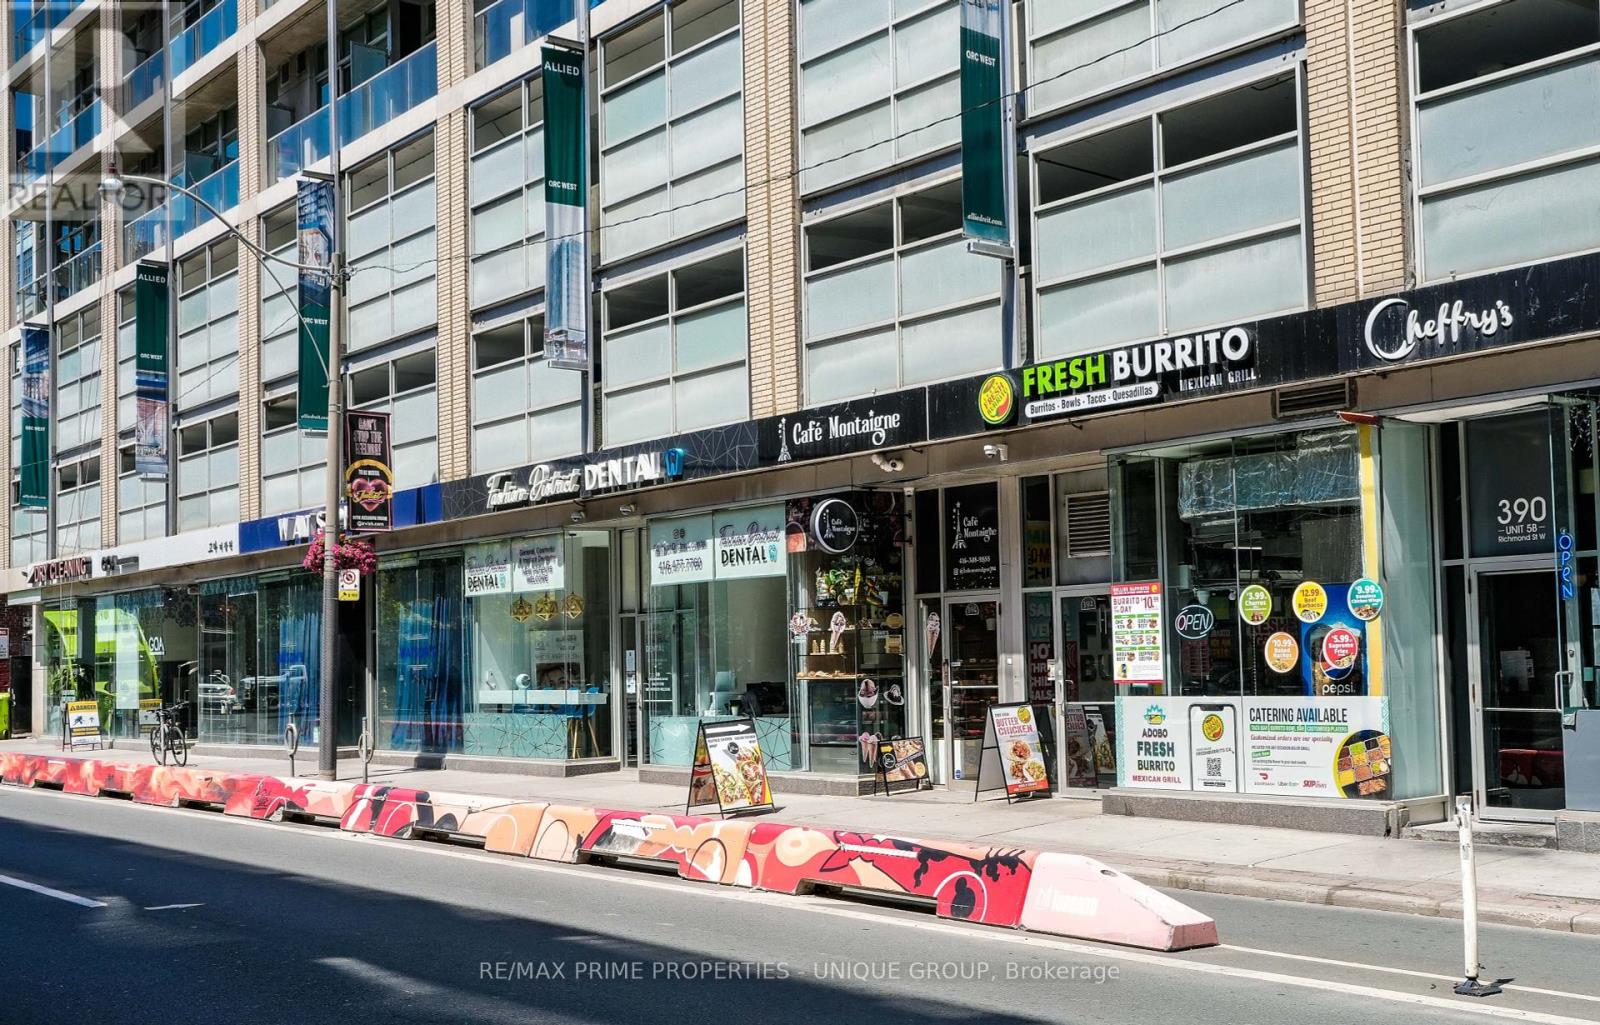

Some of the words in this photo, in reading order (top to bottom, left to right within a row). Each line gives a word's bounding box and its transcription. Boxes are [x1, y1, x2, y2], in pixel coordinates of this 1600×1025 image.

[979, 53, 996, 67] WEST
[543, 60, 581, 77] ALLIED
[561, 181, 577, 192] WEST
[138, 272, 166, 285] ALLIED
[1364, 298, 1513, 360] Cheffry's
[1022, 352, 1106, 397] FRESH
[1112, 327, 1249, 381] BURRITO
[1179, 372, 1223, 392] MEXICAN
[1228, 367, 1257, 384] GRILL
[1030, 402, 1056, 415] Burritos
[1060, 398, 1081, 409] Bowls
[1087, 393, 1107, 405] Tacos
[1112, 385, 1153, 400] Quesadillas
[792, 420, 823, 446] Café
[828, 409, 901, 446] Montaigne
[584, 451, 666, 491] DENTAL
[1497, 496, 1547, 524] 390
[963, 516, 979, 527] Café
[1498, 534, 1531, 543] Richmond
[1531, 533, 1538, 541] St
[1539, 532, 1546, 540] W
[1505, 525, 1524, 535] UNIT
[721, 545, 768, 567] DENTAL
[33, 565, 48, 583] DRY
[49, 557, 87, 581] CLEANING
[467, 573, 500, 592] DENTAL
[1178, 613, 1210, 631] OPEN
[1322, 682, 1354, 695] pepsi
[996, 717, 1019, 728] BUTTER
[1249, 707, 1294, 722] CATERING
[1296, 707, 1348, 723] AVAILABLE
[998, 725, 1034, 736] CHICKEN
[1142, 728, 1168, 739] ADOBO
[1136, 740, 1175, 758] FRESH
[1137, 759, 1176, 772] BURRITO
[1132, 775, 1162, 783] MEXICAN
[1162, 776, 1182, 784] GRILL
